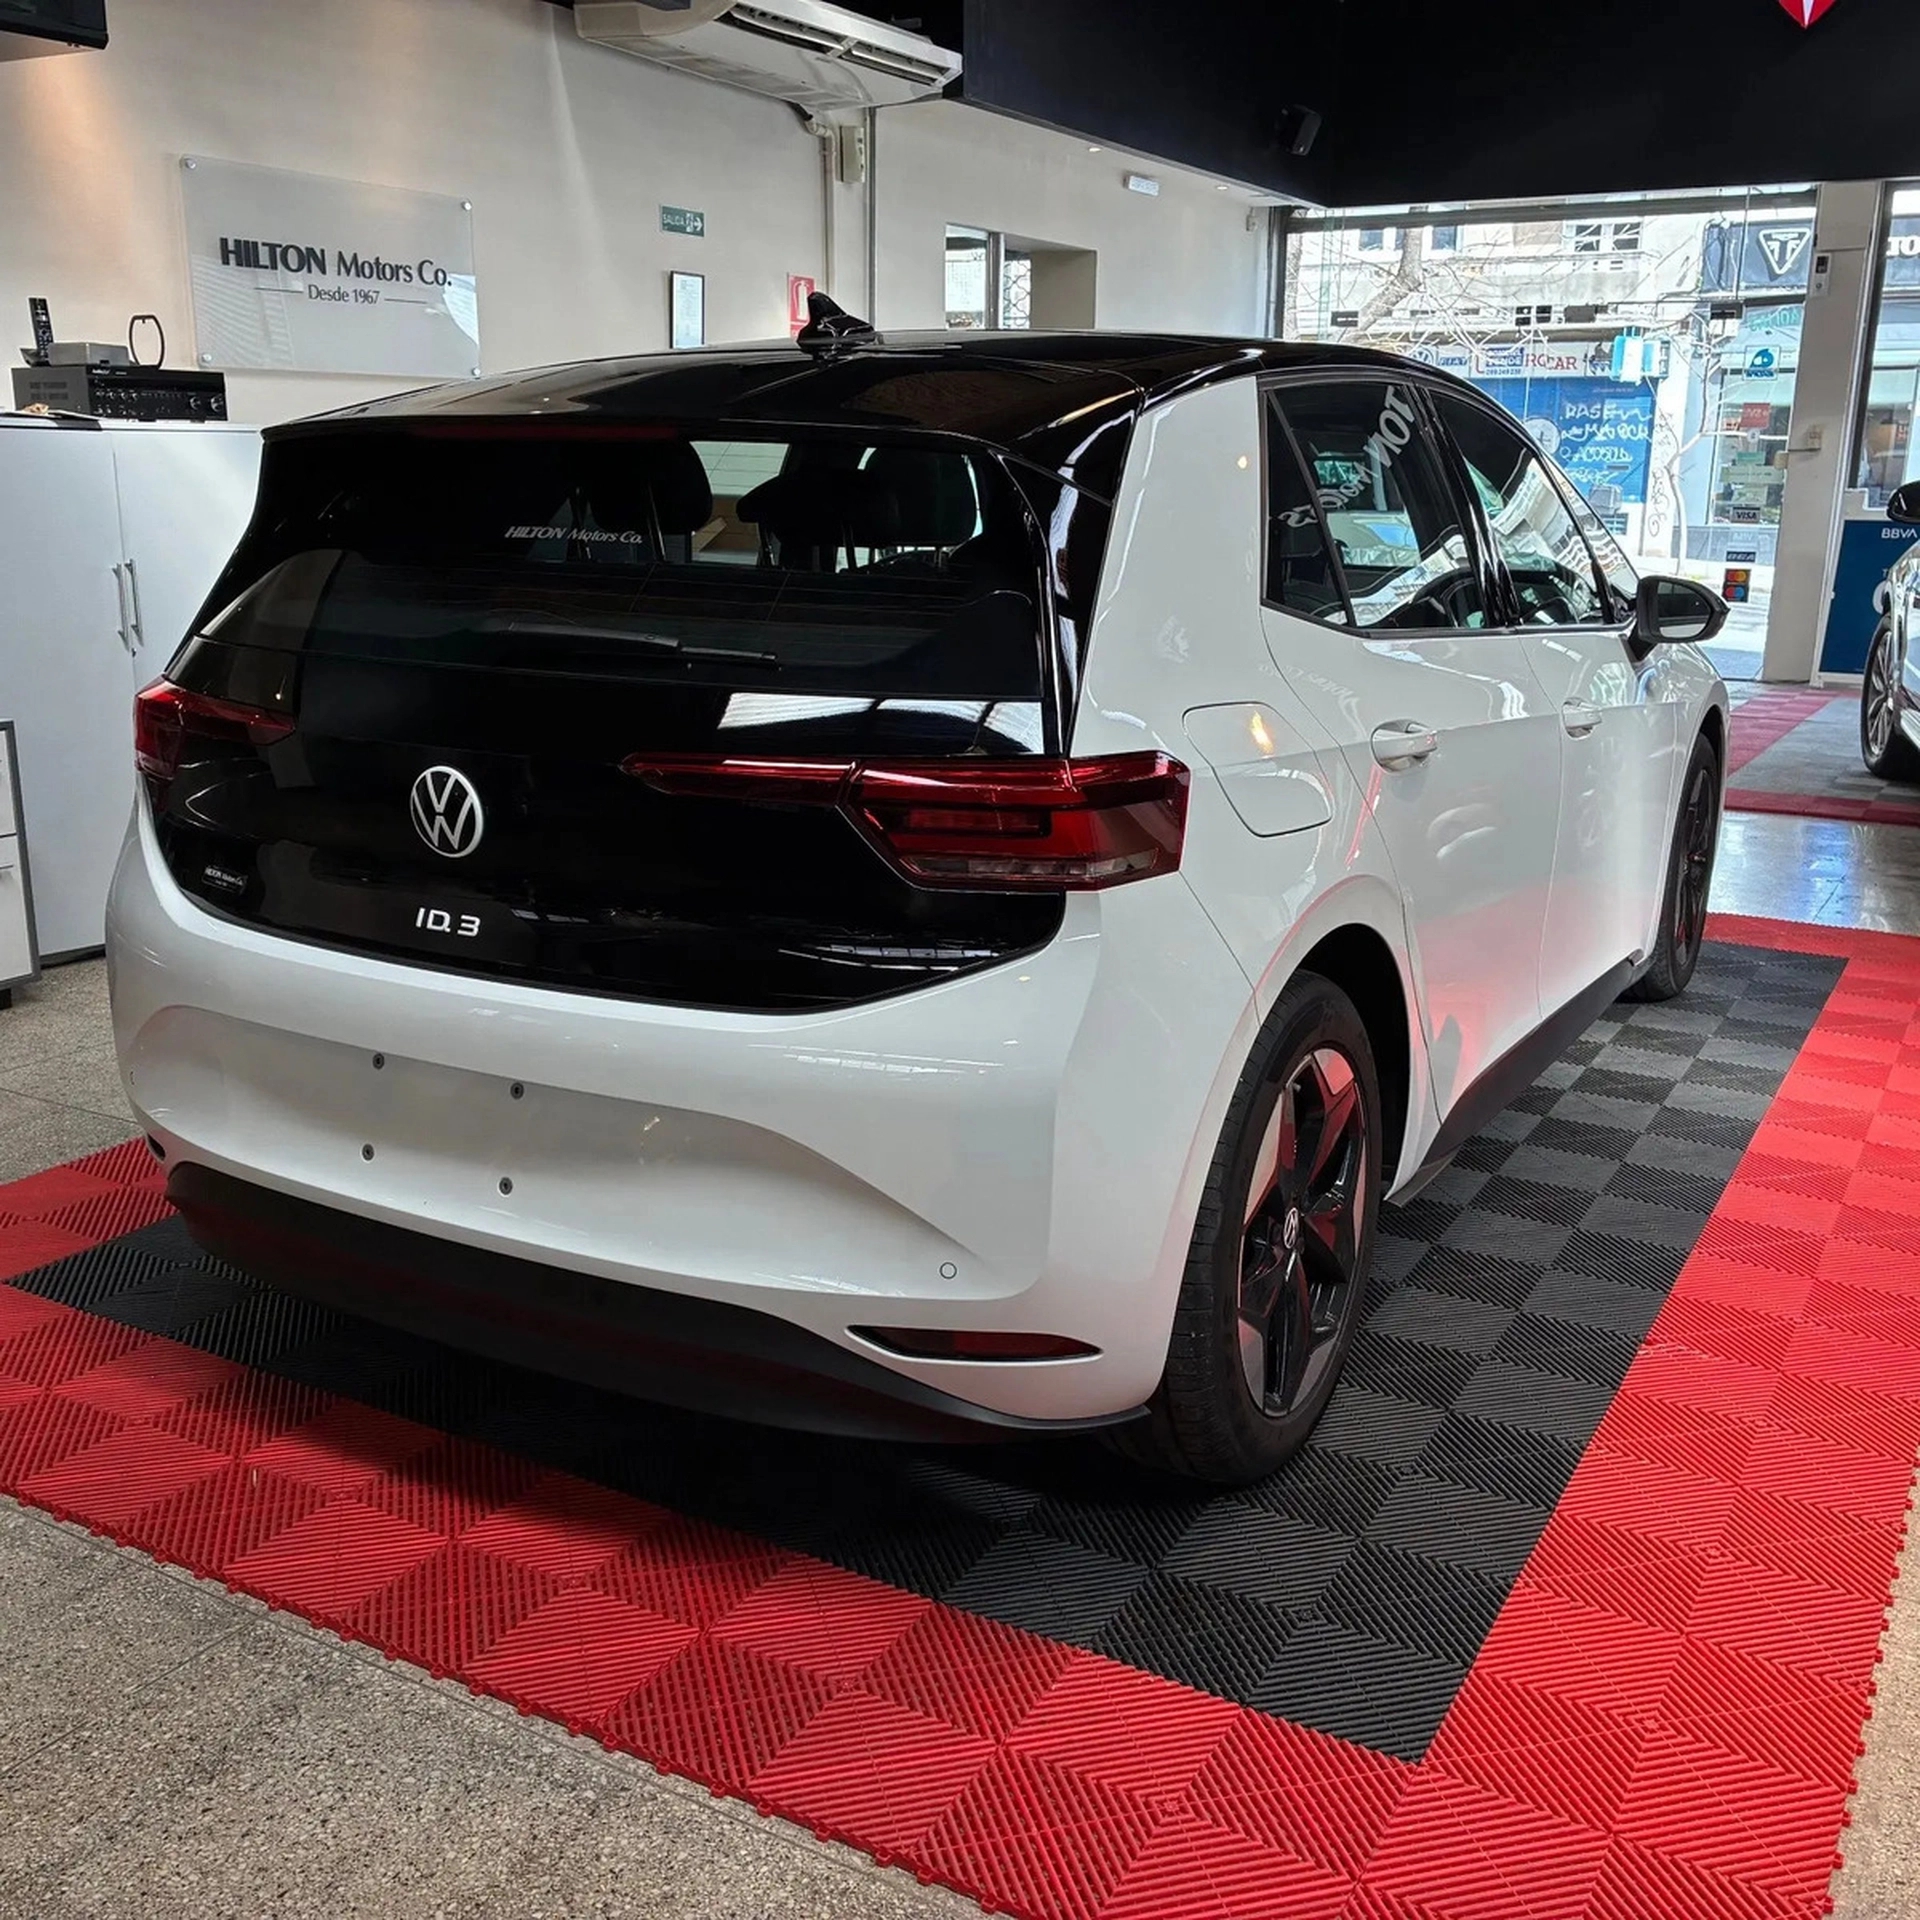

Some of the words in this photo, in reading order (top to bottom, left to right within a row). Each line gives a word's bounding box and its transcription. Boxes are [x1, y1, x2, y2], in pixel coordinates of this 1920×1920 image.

[219, 237, 327, 275] HILTON
[337, 251, 413, 283] Motors
[418, 260, 453, 287] Co.
[308, 284, 349, 302] Desde
[353, 289, 380, 305] 1967
[1736, 511, 1757, 519] VISA
[504, 526, 567, 539] HILTON
[567, 528, 618, 542] Motors
[619, 531, 643, 544] Co.
[1881, 528, 1917, 539] BBVA
